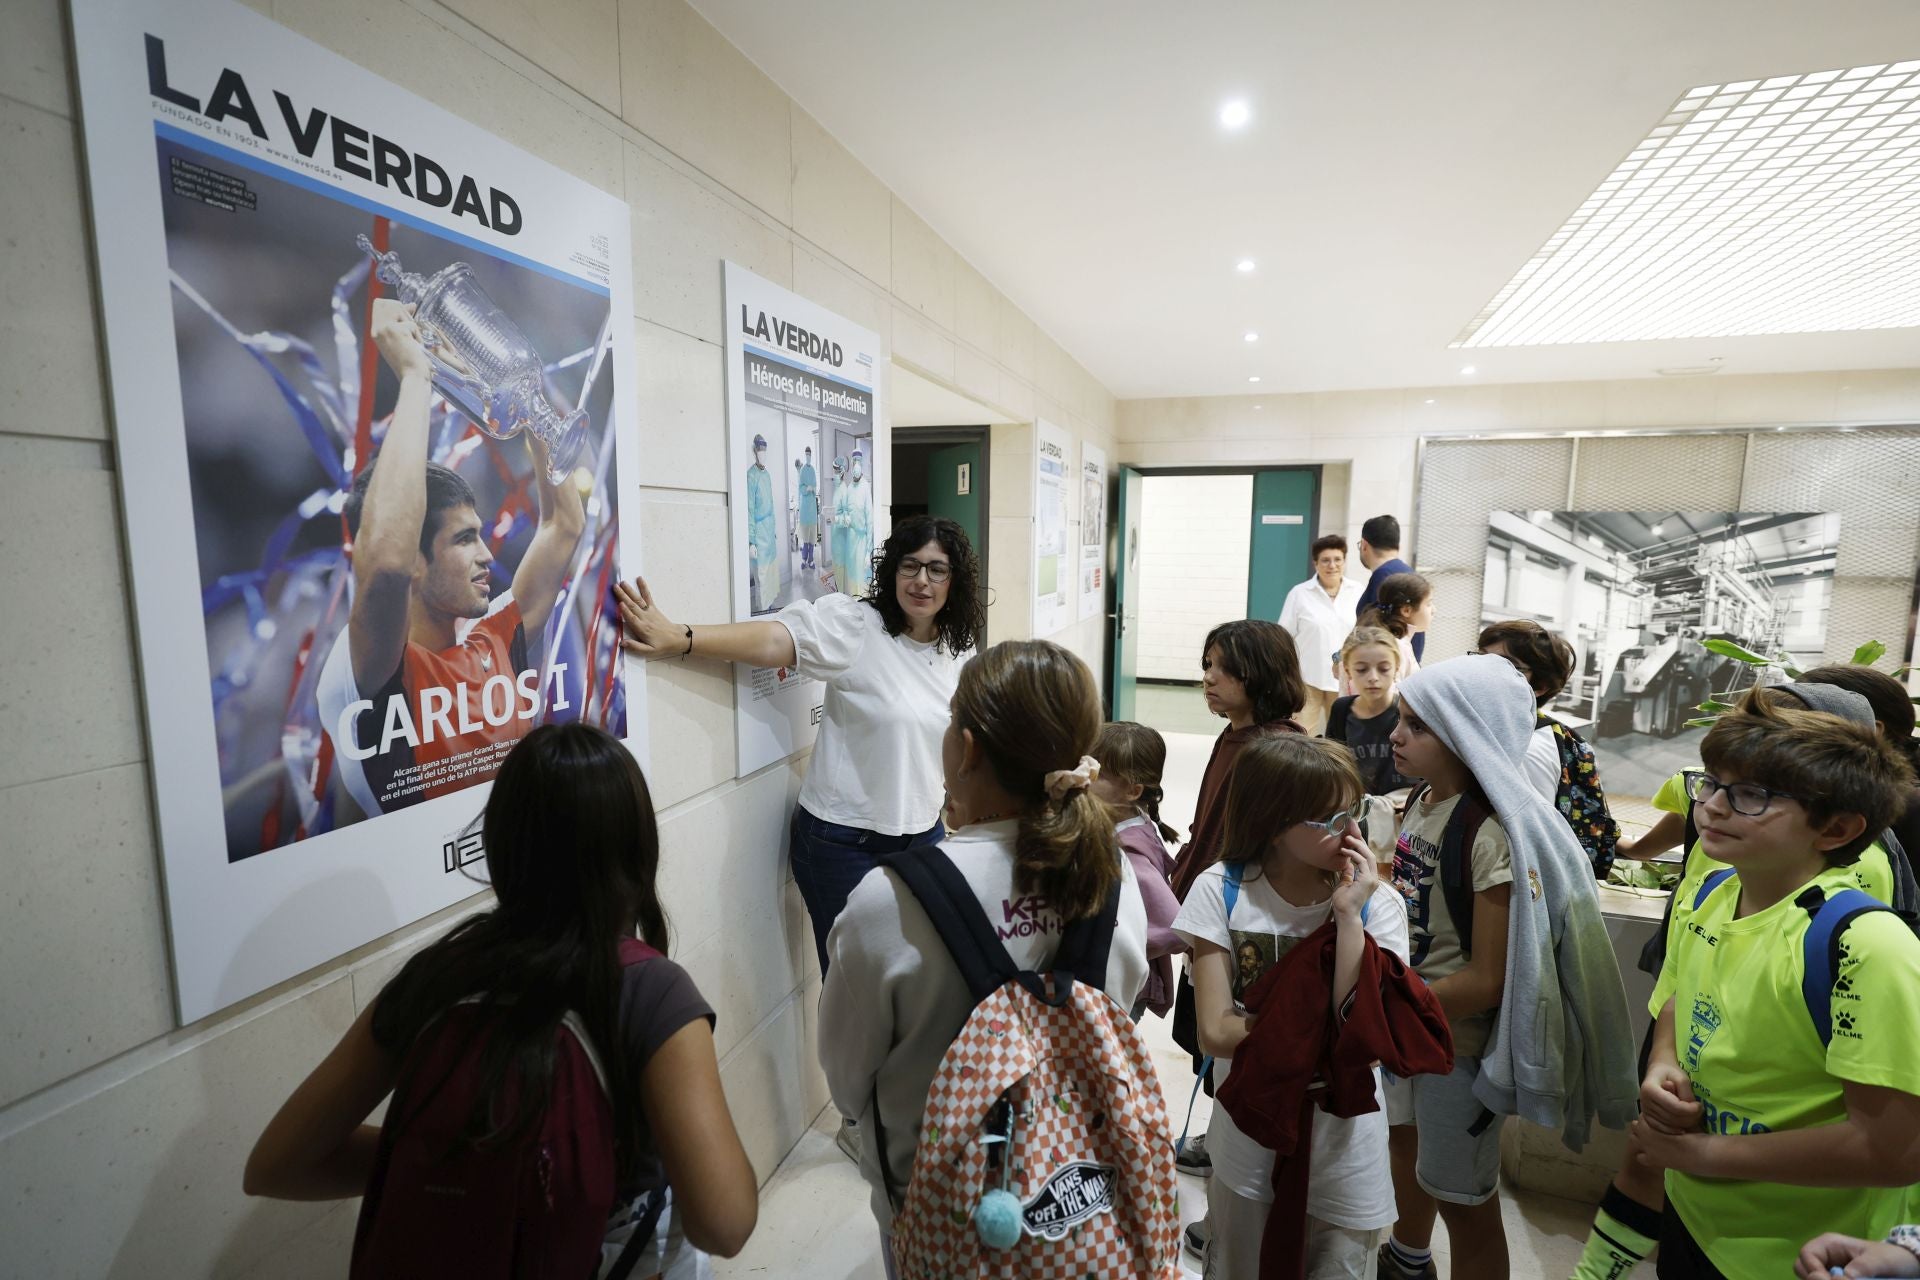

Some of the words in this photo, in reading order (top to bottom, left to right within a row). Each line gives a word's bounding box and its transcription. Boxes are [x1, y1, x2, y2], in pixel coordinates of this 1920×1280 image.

[144, 32, 268, 141] LA
[272, 89, 522, 236] VERDAD
[152, 101, 212, 130] FUNDADO
[216, 126, 231, 138] EN
[266, 147, 343, 181] www.laverdad.es
[742, 304, 770, 342] LA
[772, 316, 843, 367] VERDAD
[751, 361, 794, 394] Héroes
[796, 377, 809, 399] de
[812, 381, 820, 402] la
[822, 389, 867, 415] pandemia
[337, 669, 541, 761] CARLOS
[551, 662, 569, 712] I
[386, 782, 397, 790] en
[398, 778, 406, 787] la
[406, 773, 423, 784] final
[424, 769, 436, 780] del
[437, 767, 447, 776] US
[448, 762, 467, 774] Open
[472, 754, 495, 766] Casper
[392, 790, 401, 799] el
[401, 783, 431, 796] número
[431, 778, 446, 787] uno
[446, 774, 456, 782] de
[464, 767, 479, 777] ATP
[478, 764, 492, 773] más
[492, 760, 505, 771] jov
[393, 766, 421, 778] Alcaraz
[422, 761, 440, 771] gana
[441, 757, 449, 765] su
[450, 752, 473, 764] primer
[473, 744, 493, 756] Grand
[494, 740, 509, 750] Slam
[510, 738, 520, 746] tra
[443, 830, 485, 873] 12
[1048, 1167, 1082, 1202] VANS
[1059, 1187, 1086, 1217] THE
